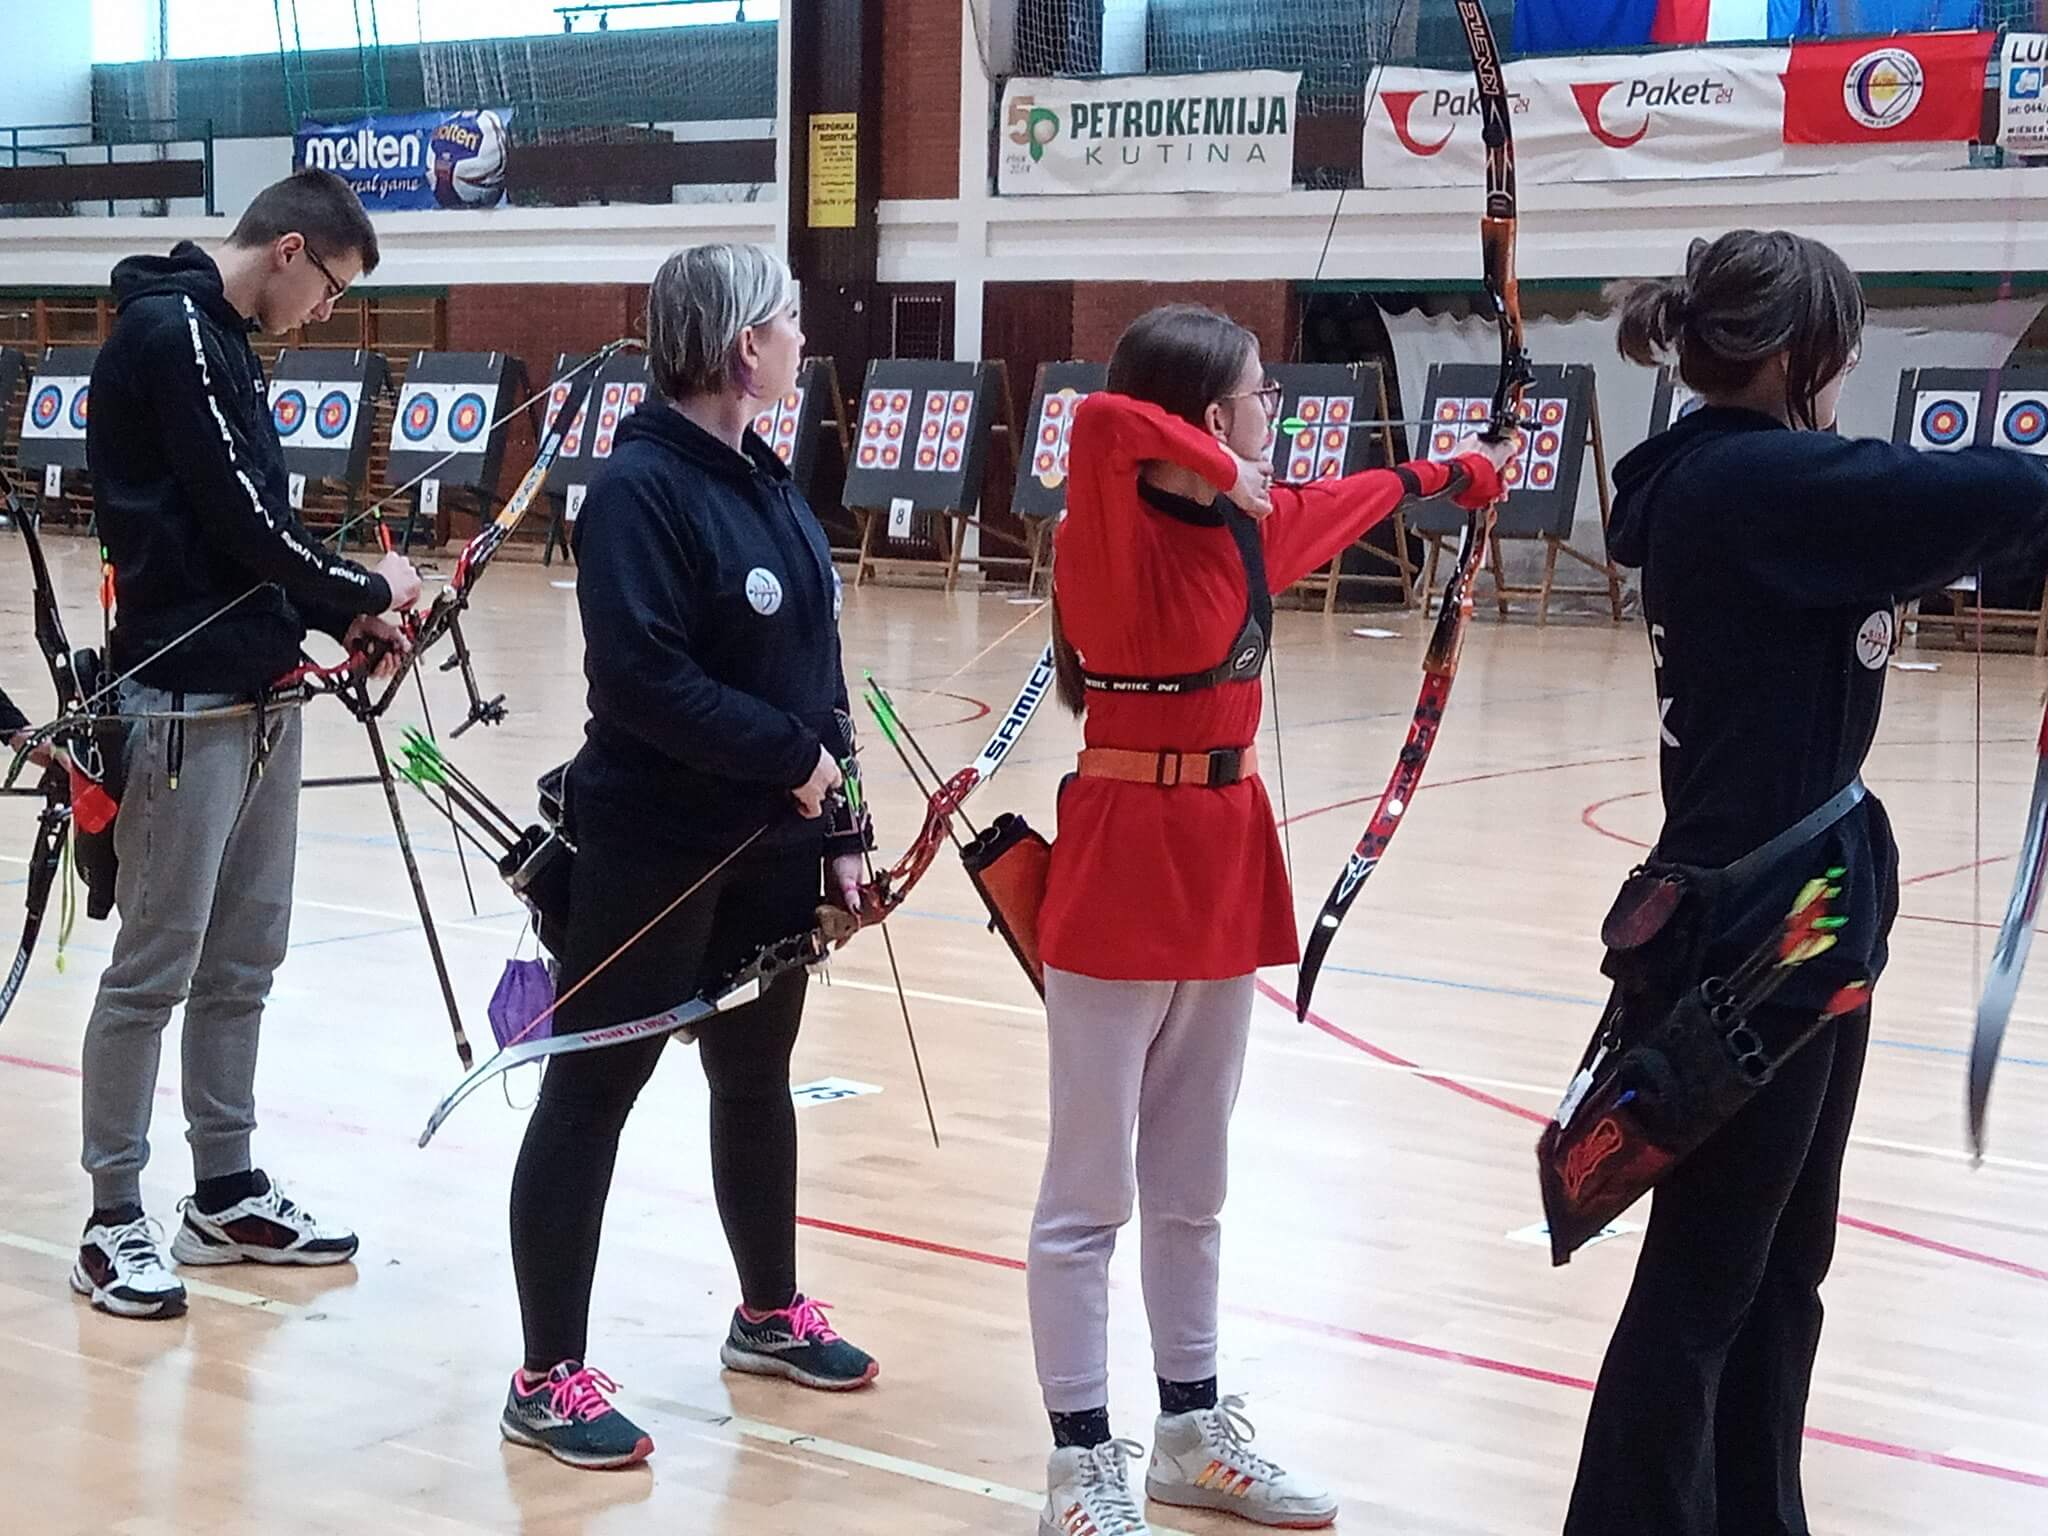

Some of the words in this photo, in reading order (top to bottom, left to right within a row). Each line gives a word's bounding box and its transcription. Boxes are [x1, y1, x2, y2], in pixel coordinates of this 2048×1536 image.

[1459, 1, 1500, 95] KINETIC
[1626, 79, 1723, 107] Paket
[1715, 88, 1734, 103] 24
[1069, 96, 1288, 139] PETROKEMIJA
[305, 129, 421, 171] molten
[1085, 143, 1266, 166] KUTINA
[380, 177, 420, 200] game
[426, 487, 433, 503] 5
[896, 508, 905, 526] 8
